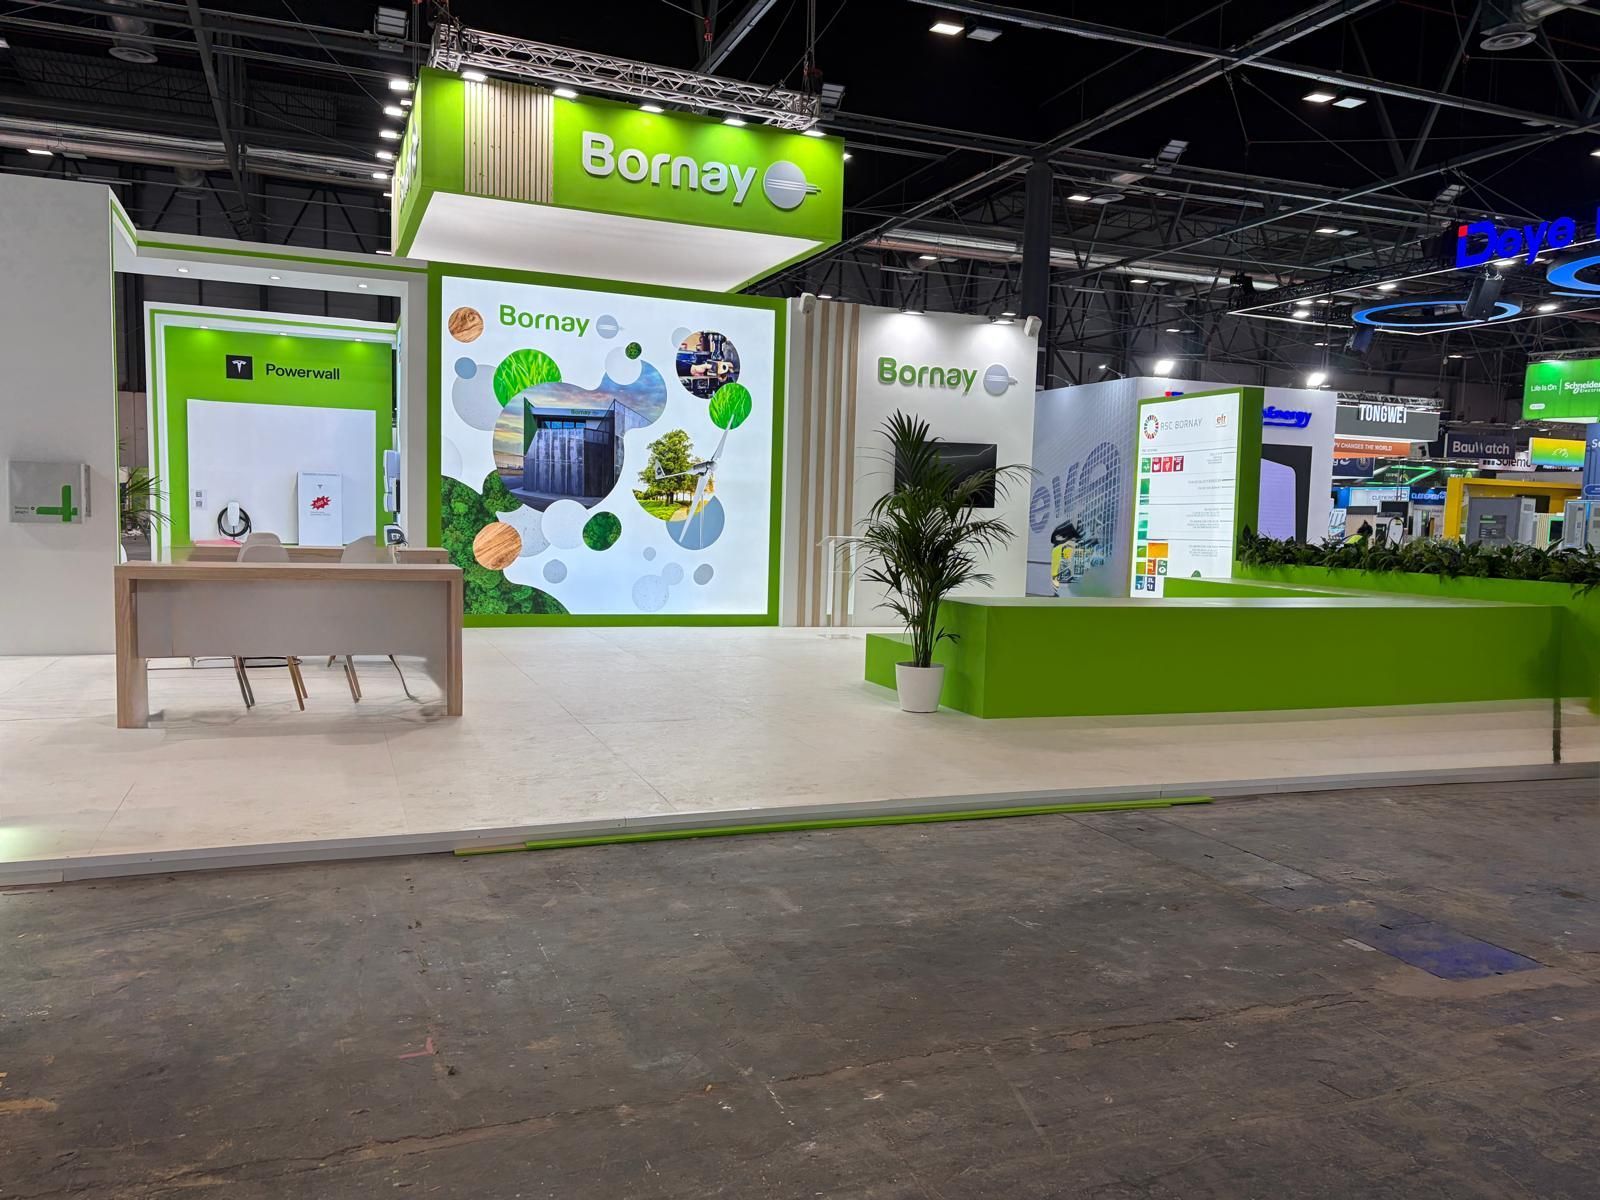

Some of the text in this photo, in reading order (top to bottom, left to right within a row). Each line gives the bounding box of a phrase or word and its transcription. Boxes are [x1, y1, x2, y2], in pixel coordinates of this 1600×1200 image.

[582, 130, 757, 204] Bornay
[1456, 216, 1577, 268] Deye
[500, 304, 590, 337] Bornay
[265, 363, 340, 380] Powerwall
[878, 356, 978, 396] Bornay
[1160, 417, 1202, 431] RSC BORNAY
[1360, 404, 1407, 424] TONGWEI
[1592, 439, 1600, 448] S
